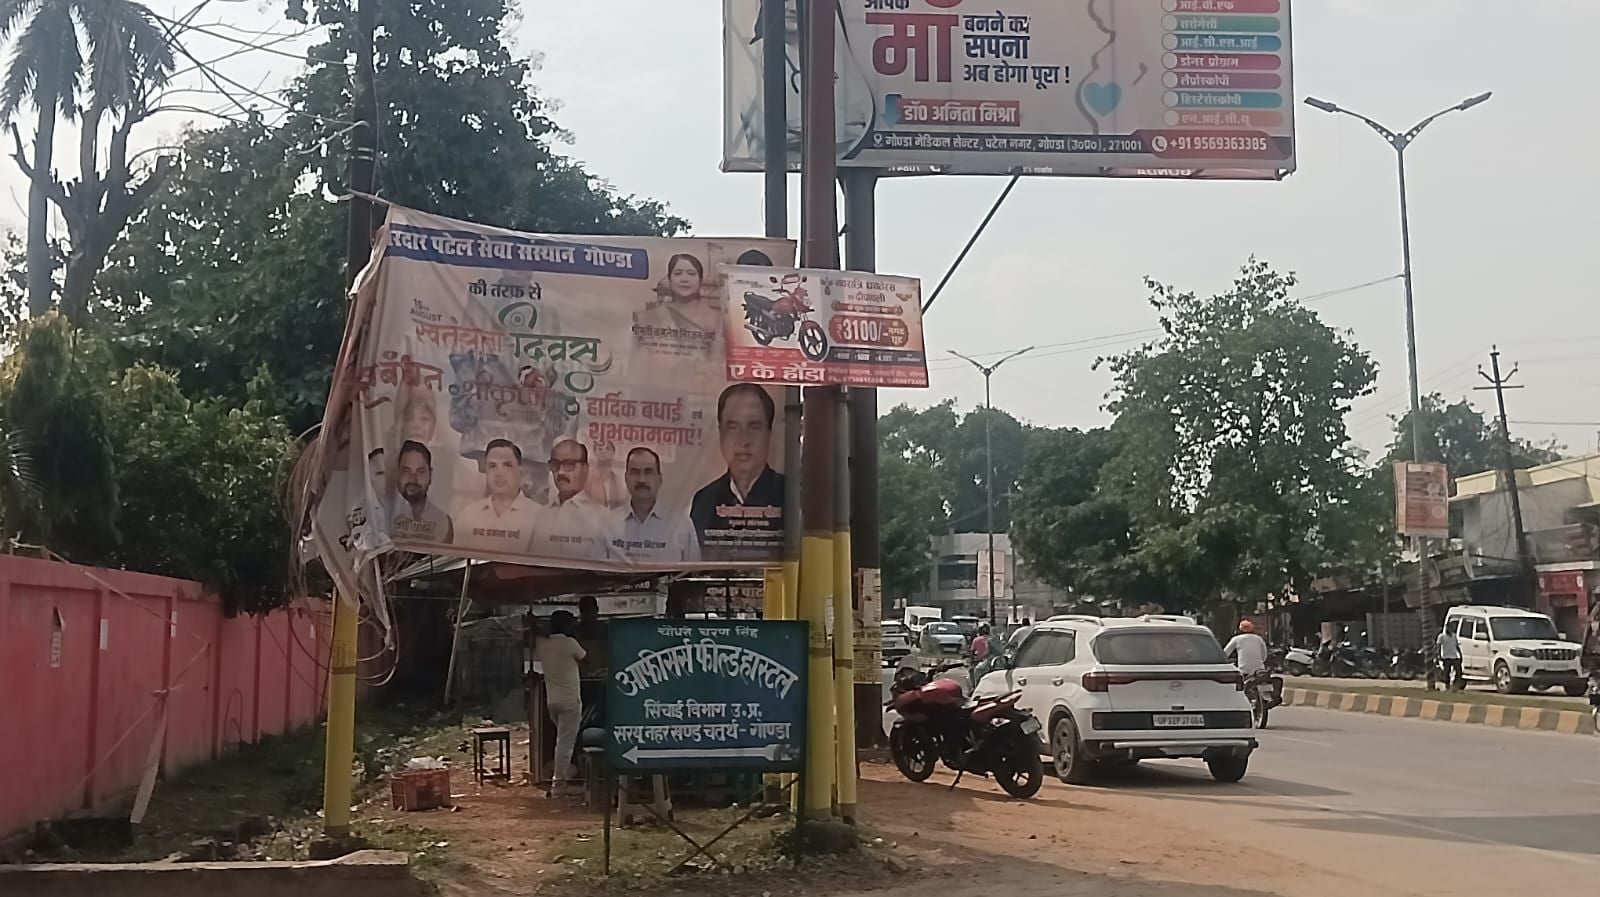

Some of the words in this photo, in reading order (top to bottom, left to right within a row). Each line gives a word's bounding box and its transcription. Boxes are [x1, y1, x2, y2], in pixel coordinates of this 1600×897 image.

[963, 11, 1005, 33] बनने
[865, 0, 960, 82] मा
[963, 35, 1030, 60] सपना
[1180, 54, 1205, 67] डोनर
[1208, 55, 1239, 68] प्रोग्राम
[964, 65, 990, 82] अब
[993, 61, 1028, 83] होगा
[1031, 64, 1060, 89] पूरा
[931, 102, 977, 122] अनिता
[979, 103, 1017, 122] मिश्रा
[885, 134, 913, 147] गोण्डा
[914, 134, 950, 147] मेडिकल
[986, 136, 1008, 148] पटेल
[1039, 137, 1065, 149] गोण्डा
[1109, 139, 1141, 151] 271001
[1170, 137, 1191, 150] +91
[431, 233, 474, 256] पटेल
[477, 236, 512, 260] सेवा
[517, 239, 576, 264] संस्थान
[583, 246, 633, 268] गोण्डा
[468, 279, 487, 297] की
[528, 282, 542, 300] से
[729, 363, 746, 380] ए
[751, 361, 777, 379] के
[782, 361, 826, 382] होंडा
[585, 391, 637, 418] हार्दिक
[640, 397, 683, 421] बधाई
[697, 626, 731, 638] चरण
[734, 625, 759, 639] सिंह
[643, 698, 684, 720] सिंचाई
[686, 698, 727, 719] विभाग
[644, 725, 670, 744] नहर
[750, 718, 792, 740] गोण्डा
